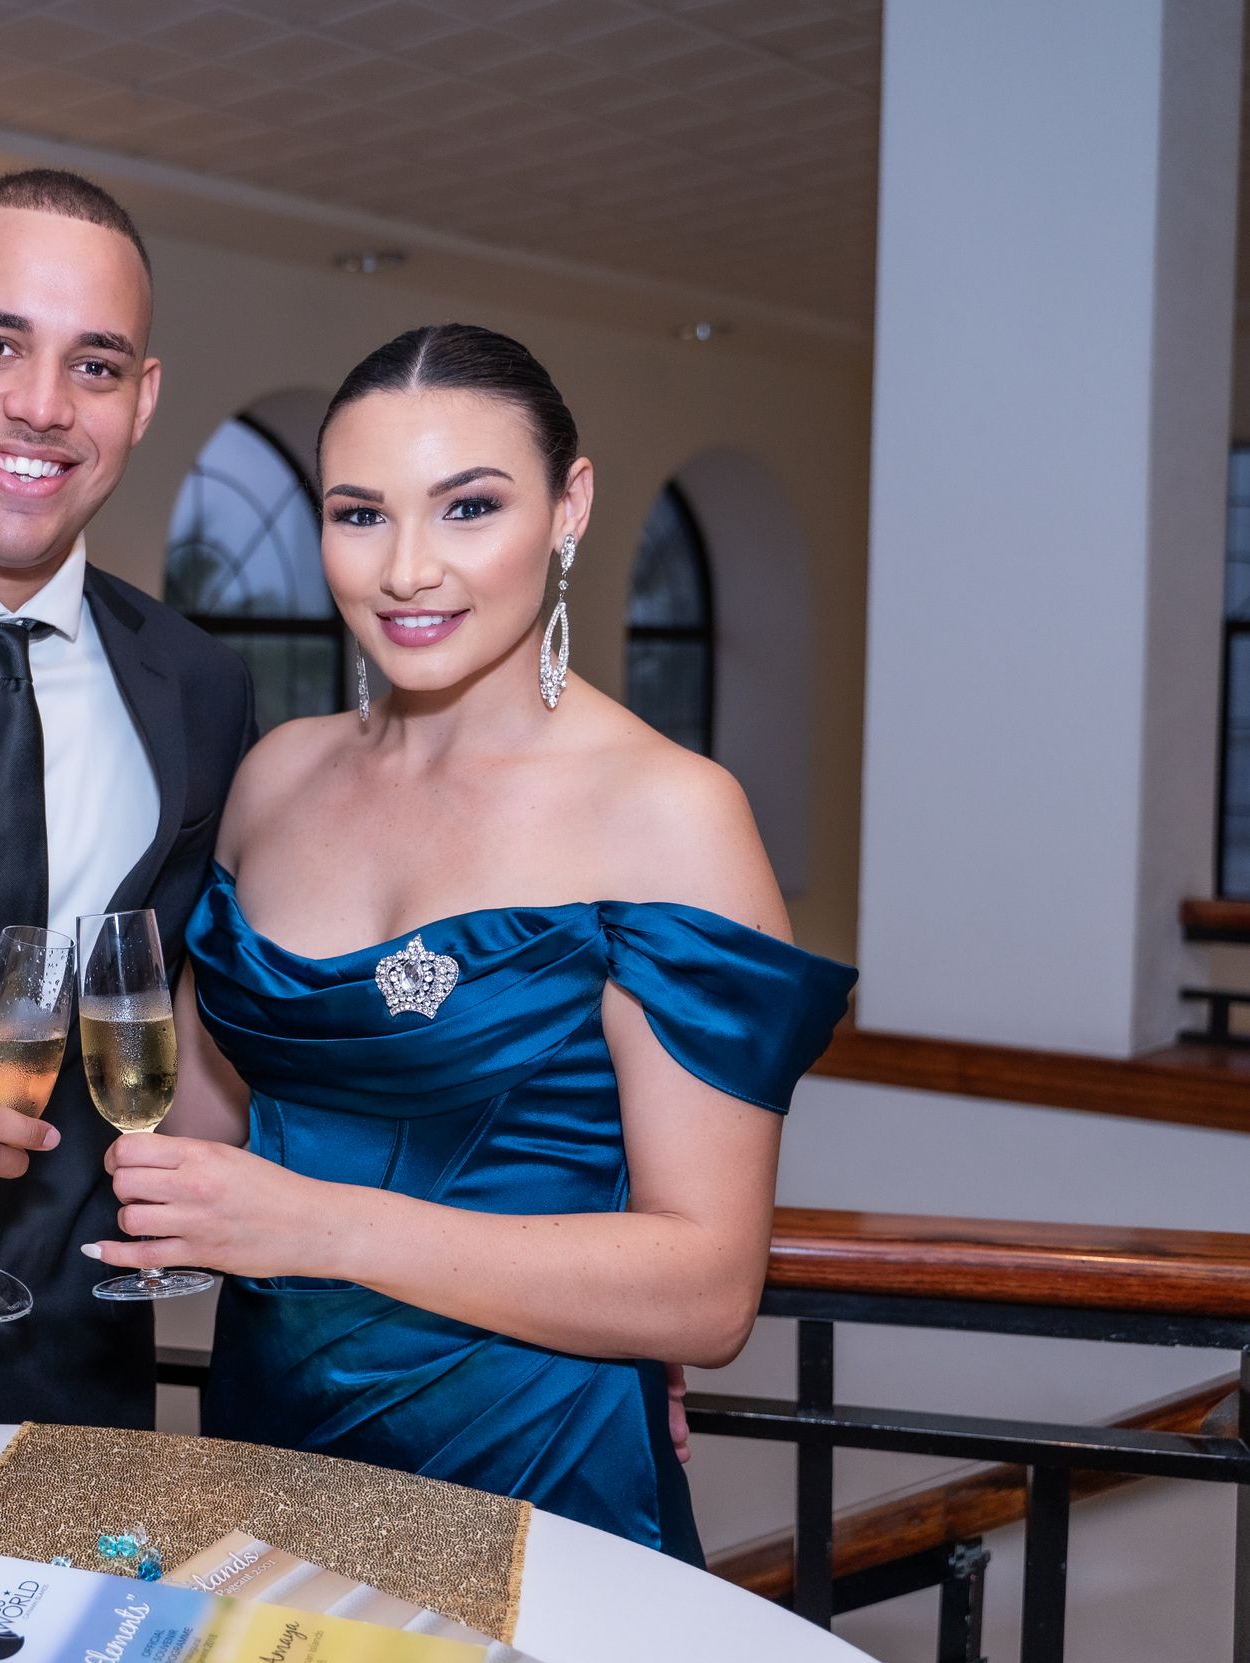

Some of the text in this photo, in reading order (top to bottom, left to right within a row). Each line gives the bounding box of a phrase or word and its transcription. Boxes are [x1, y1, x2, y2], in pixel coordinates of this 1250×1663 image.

[191, 1551, 259, 1592] lands
[214, 1559, 277, 1597] Pageant 2001
[142, 1630, 165, 1657] OFFICIAL
[165, 1627, 193, 1663] OGRAMME
